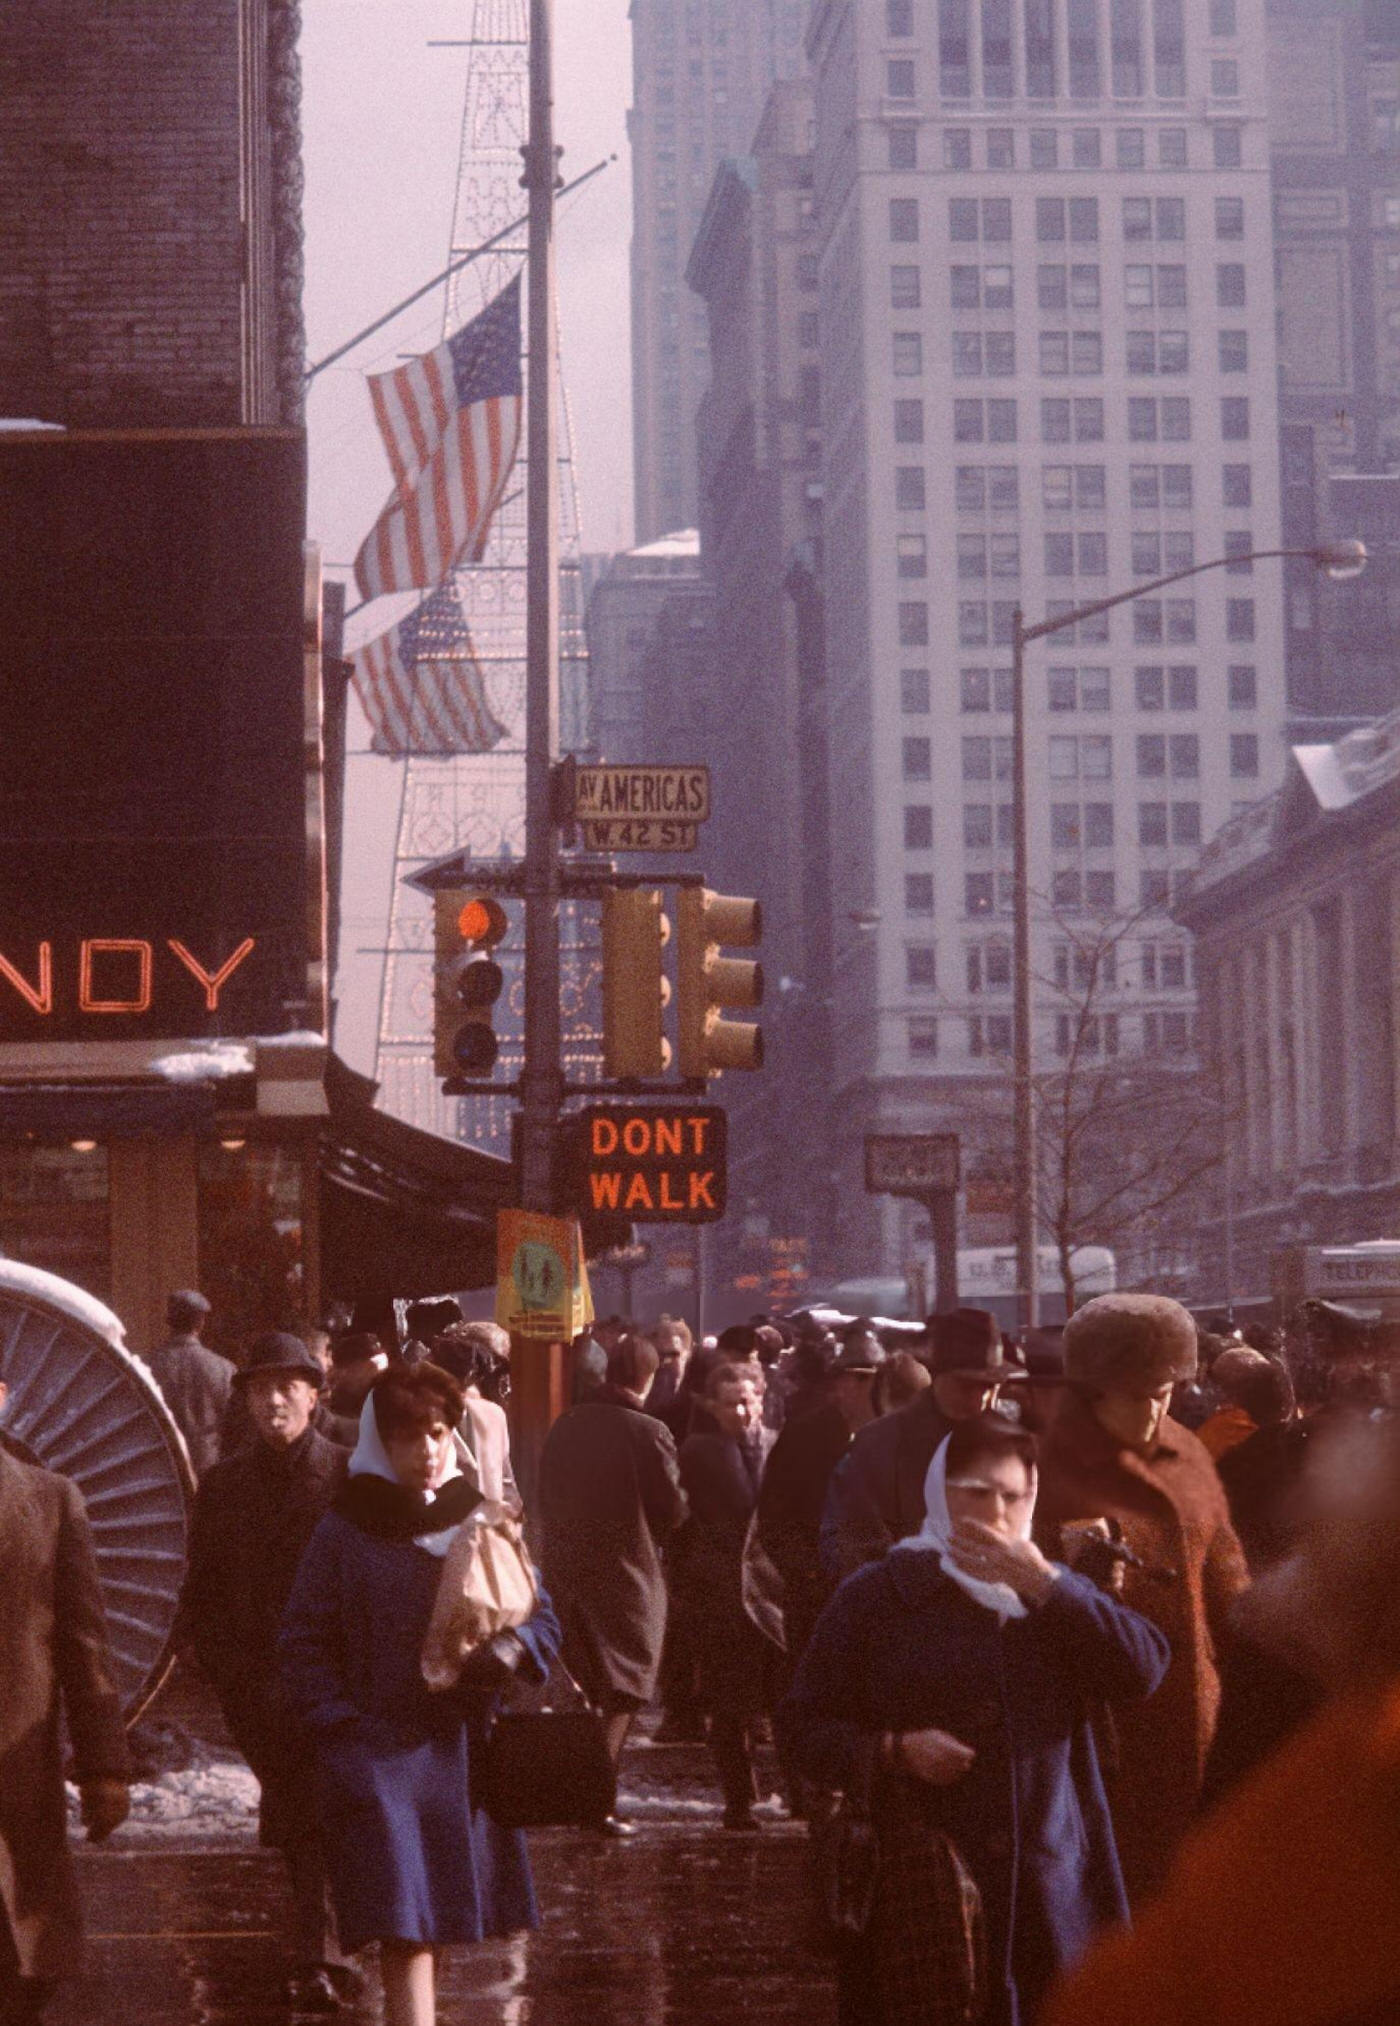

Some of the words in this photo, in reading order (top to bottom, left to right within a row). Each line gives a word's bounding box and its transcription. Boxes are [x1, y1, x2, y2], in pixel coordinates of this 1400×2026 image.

[600, 774, 703, 811] AMERICAS
[619, 823, 649, 845] 42
[661, 822, 688, 845] ST
[592, 1117, 710, 1156] DONT
[589, 1172, 716, 1209] WALK
